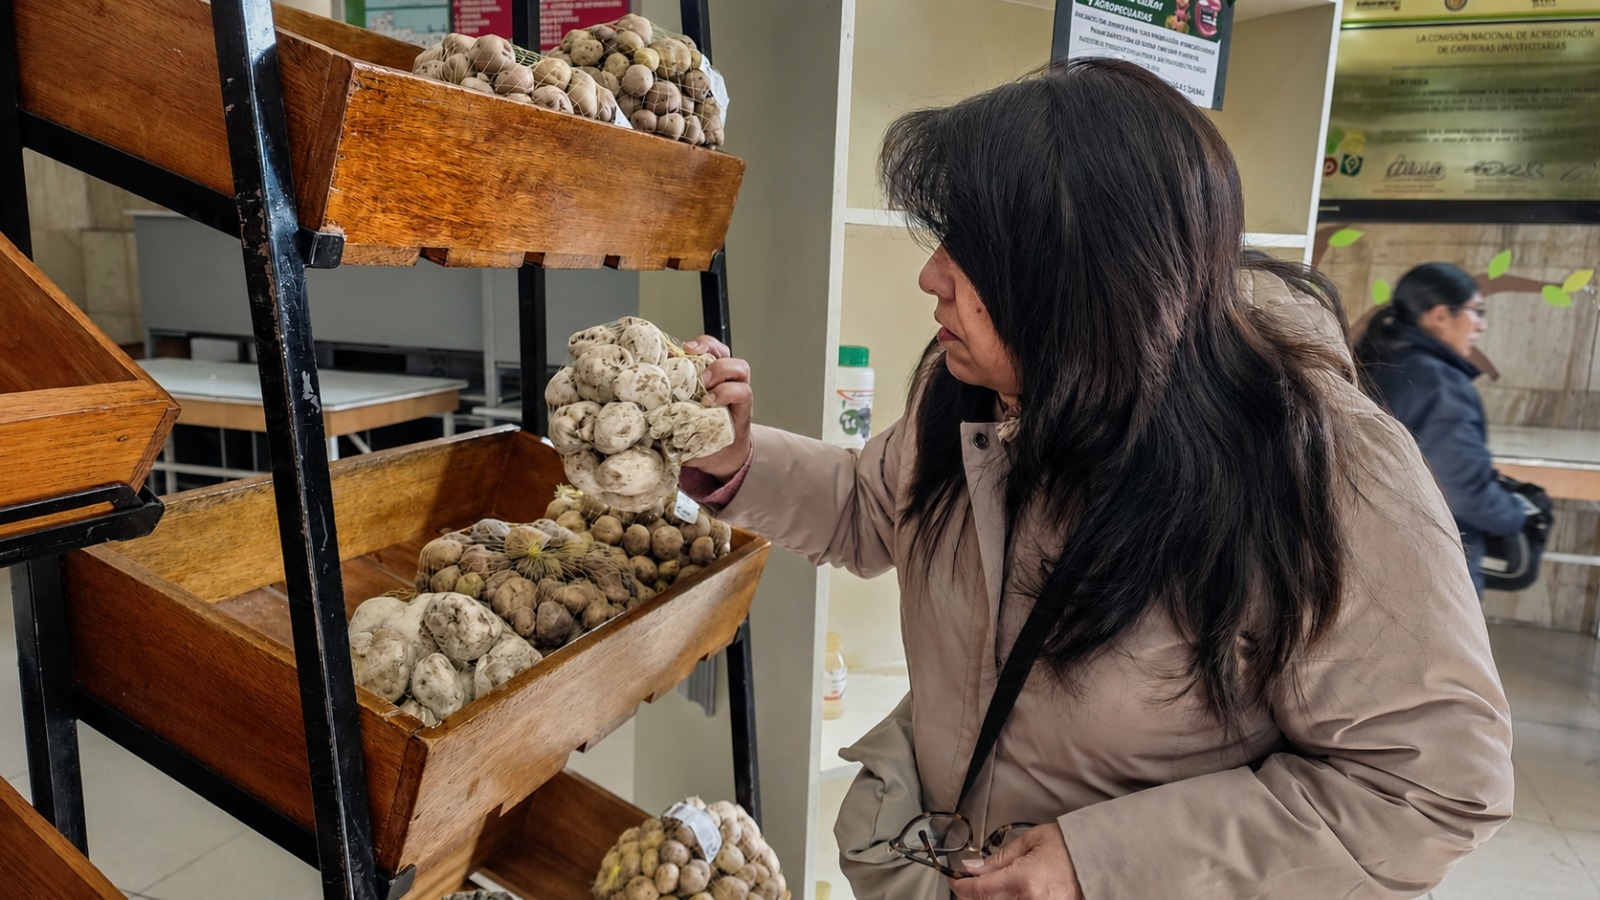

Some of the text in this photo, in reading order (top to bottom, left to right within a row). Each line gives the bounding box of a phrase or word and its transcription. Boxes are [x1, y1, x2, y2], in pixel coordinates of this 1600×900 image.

[1416, 27, 1594, 43] LA COMISIÓN NACIONAL DE ACREDITACIÓN
[1437, 45, 1448, 55] DE
